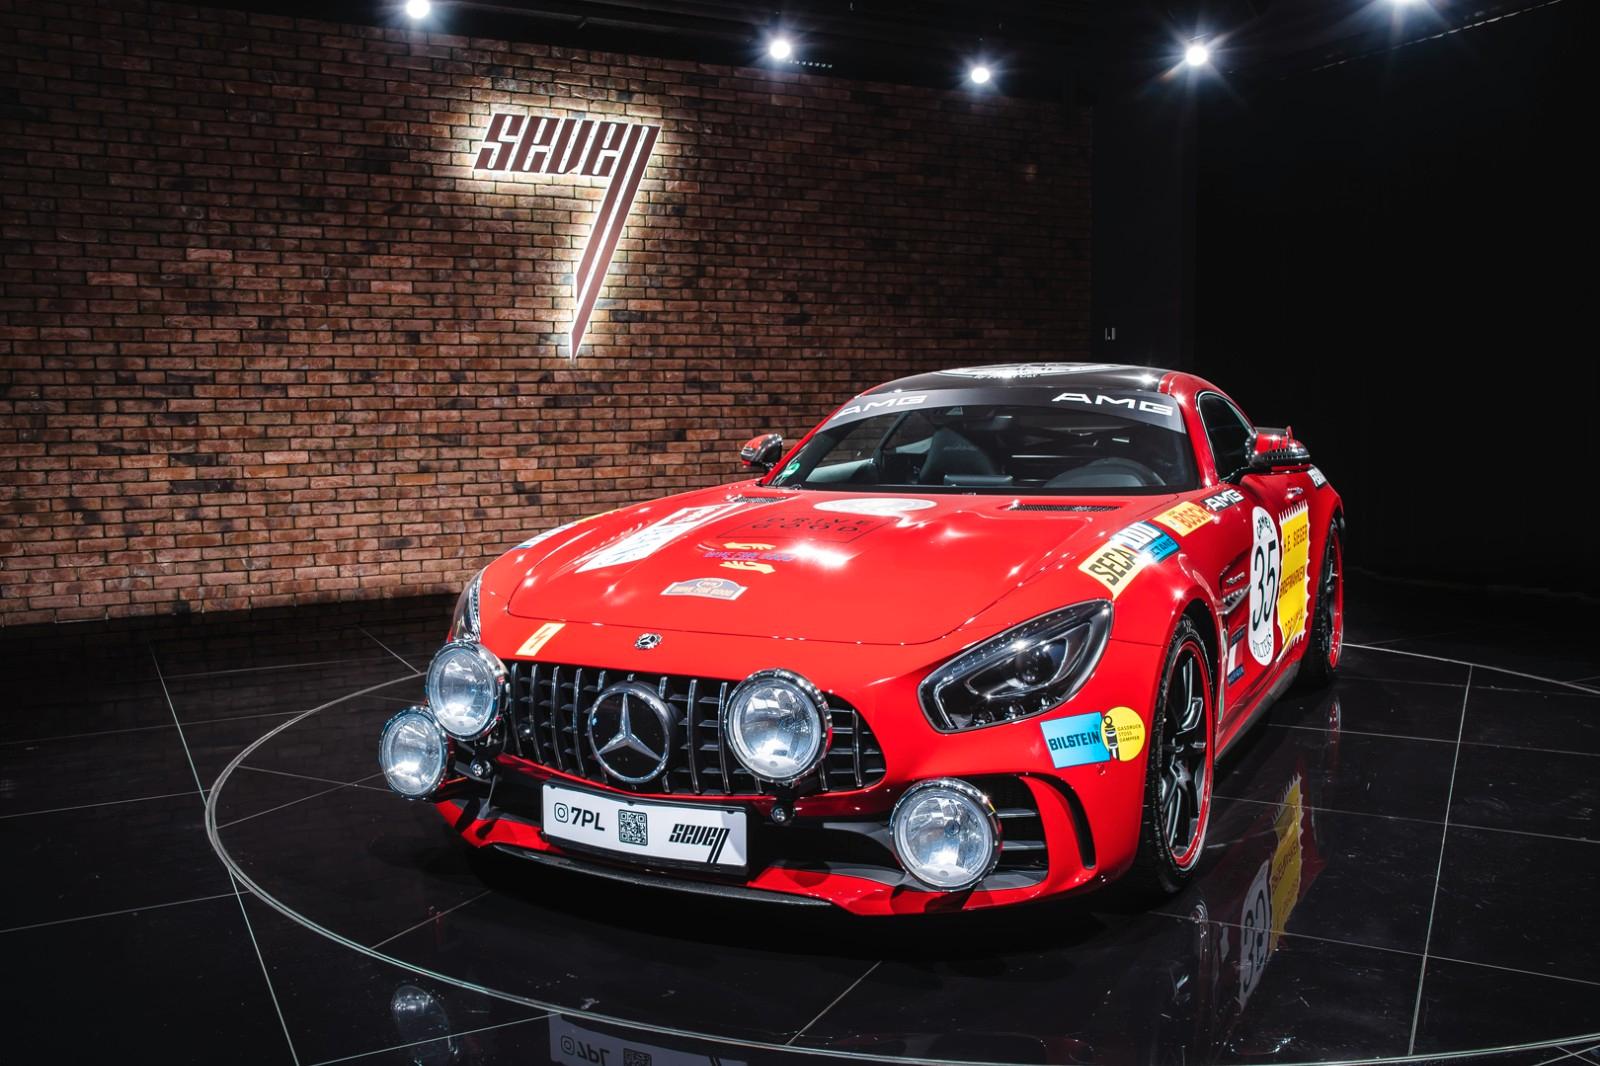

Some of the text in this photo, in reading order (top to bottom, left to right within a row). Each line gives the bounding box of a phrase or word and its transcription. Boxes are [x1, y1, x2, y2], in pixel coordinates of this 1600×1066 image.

[832, 394, 929, 420] AMG
[1051, 392, 1174, 416] AMG
[1203, 489, 1245, 511] AMG
[1088, 547, 1139, 586] SECA
[1252, 539, 1277, 632] 35
[1047, 731, 1101, 751] BILSTEIN
[570, 806, 605, 831] 7PL
